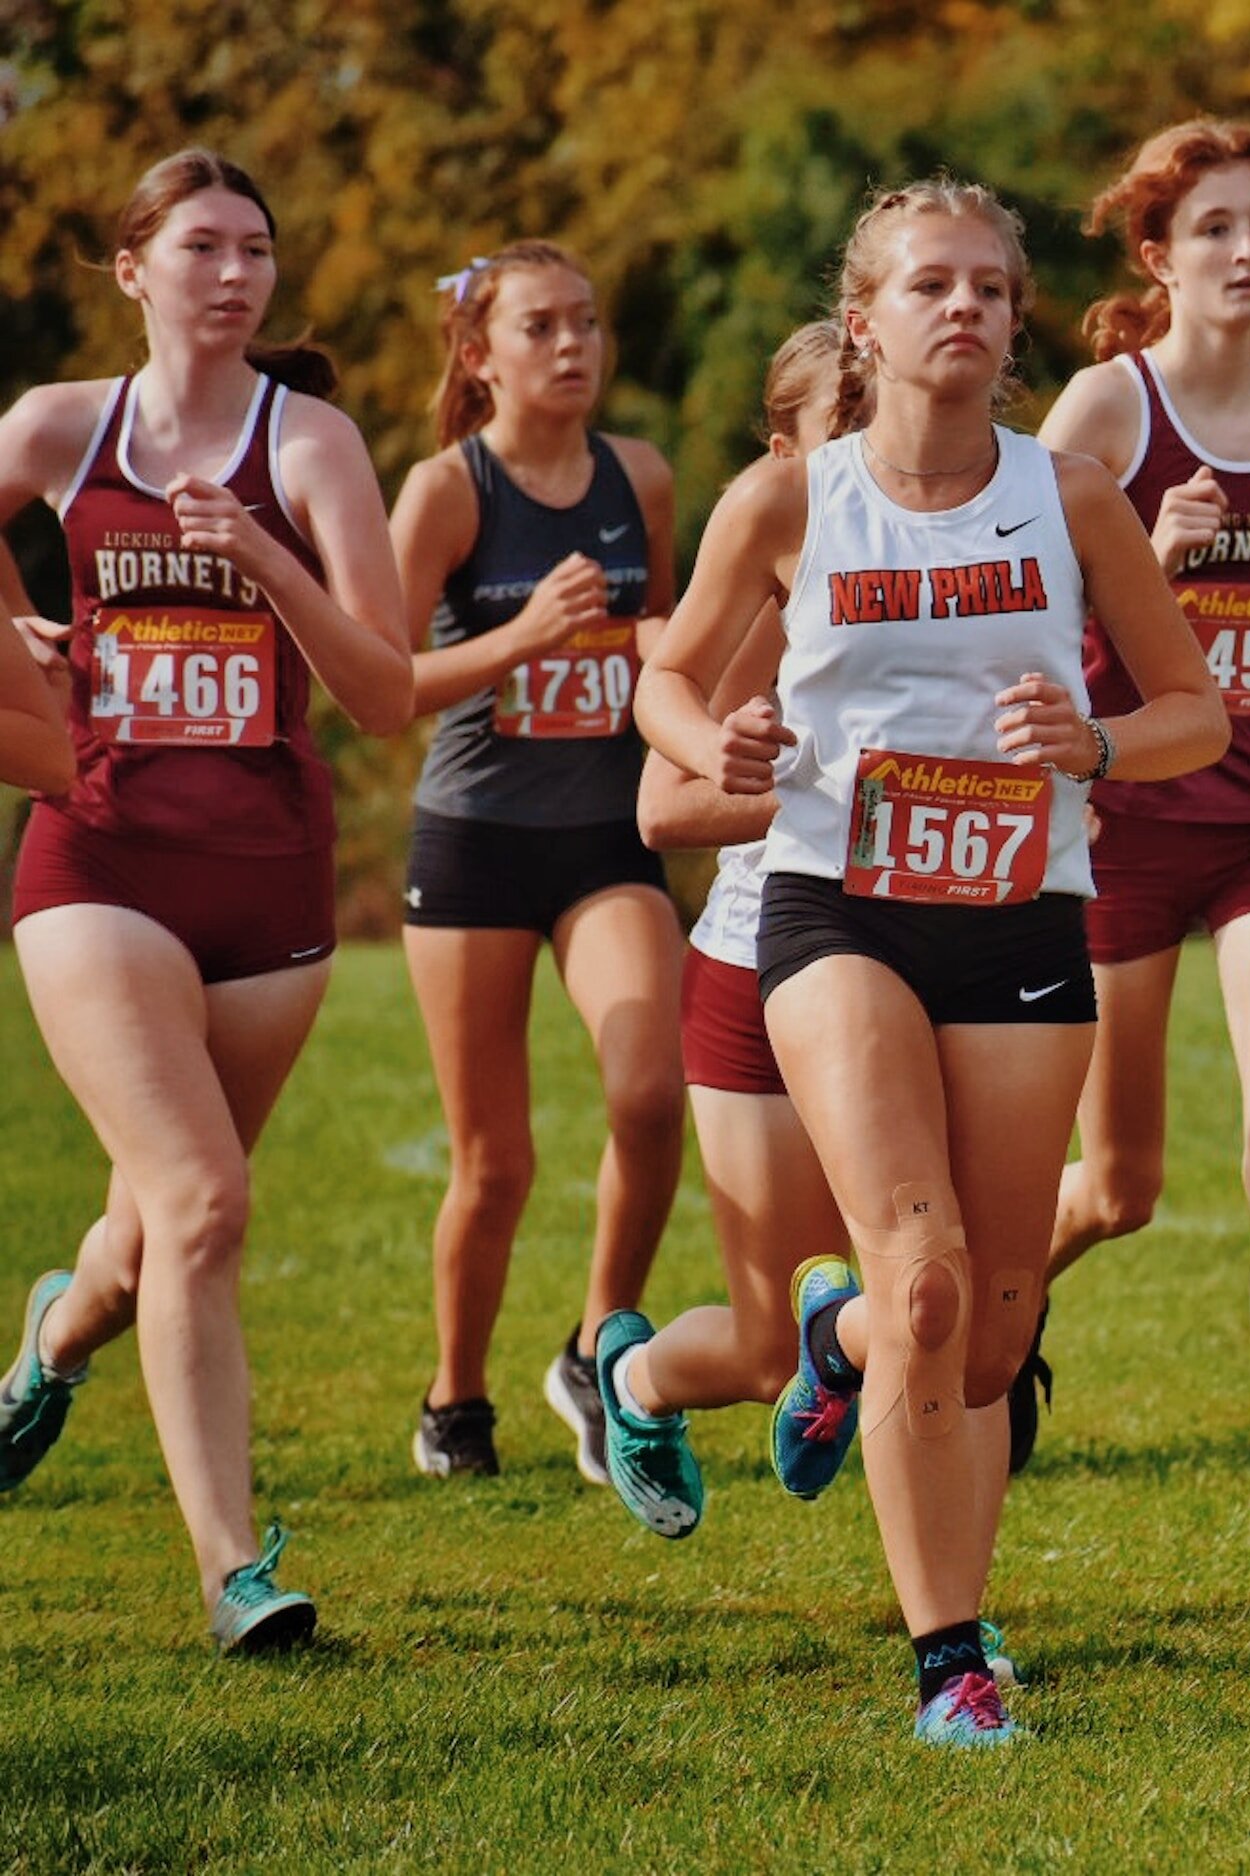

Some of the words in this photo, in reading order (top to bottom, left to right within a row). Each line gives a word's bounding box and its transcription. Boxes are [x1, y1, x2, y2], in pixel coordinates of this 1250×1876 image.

[104, 531, 173, 548] LICKING
[828, 568, 922, 626] NEW
[927, 557, 1047, 619] PHILA
[103, 614, 217, 642] Athletic
[105, 652, 260, 718] 1466
[511, 655, 632, 713] 1730
[183, 724, 225, 737] FIRST
[867, 758, 994, 798] Athletic
[998, 780, 1038, 798] NET
[872, 801, 1035, 880] 1567
[947, 884, 991, 897] FIRST
[912, 1202, 929, 1214] KT
[1003, 1290, 1019, 1301] KT
[923, 1401, 939, 1414] KT
